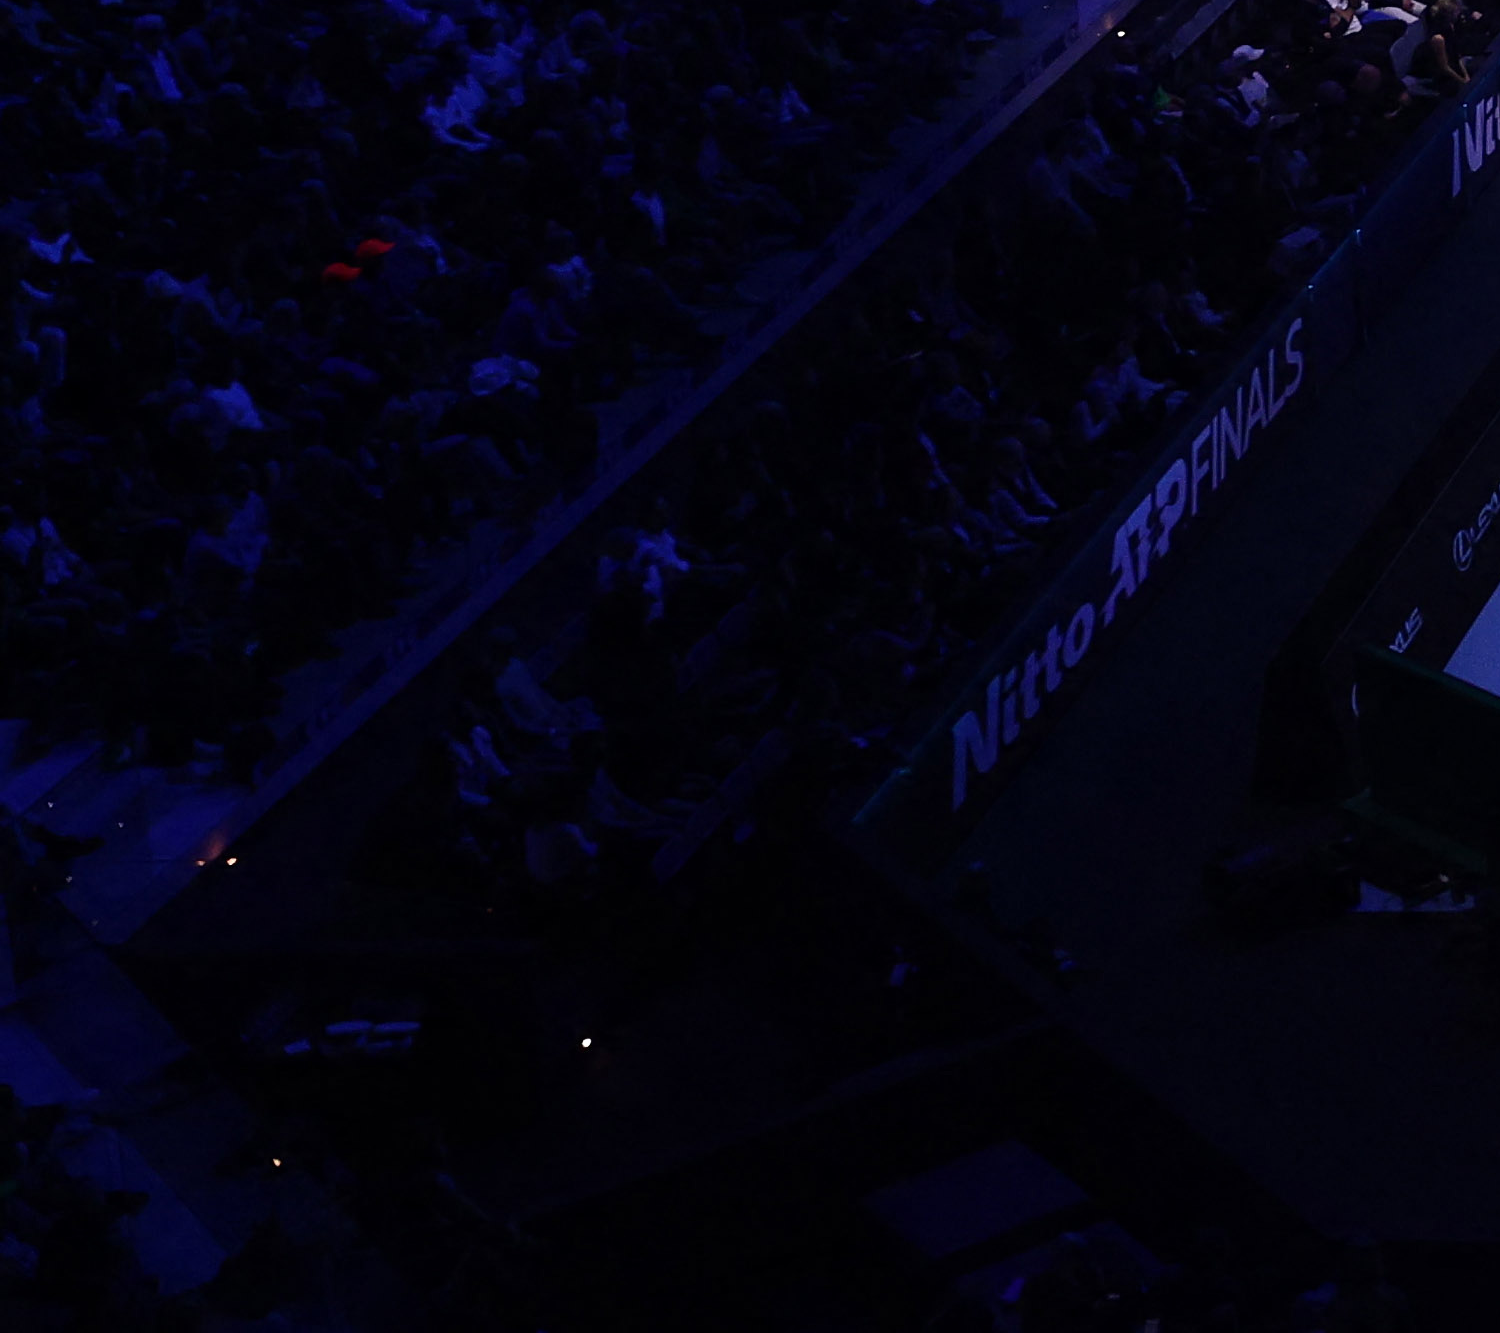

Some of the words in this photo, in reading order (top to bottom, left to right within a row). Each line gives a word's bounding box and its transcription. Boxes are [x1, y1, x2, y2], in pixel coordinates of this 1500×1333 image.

[950, 603, 1097, 812] Nitto
[1096, 456, 1188, 630] ATP
[1188, 316, 1306, 519] FINALS
